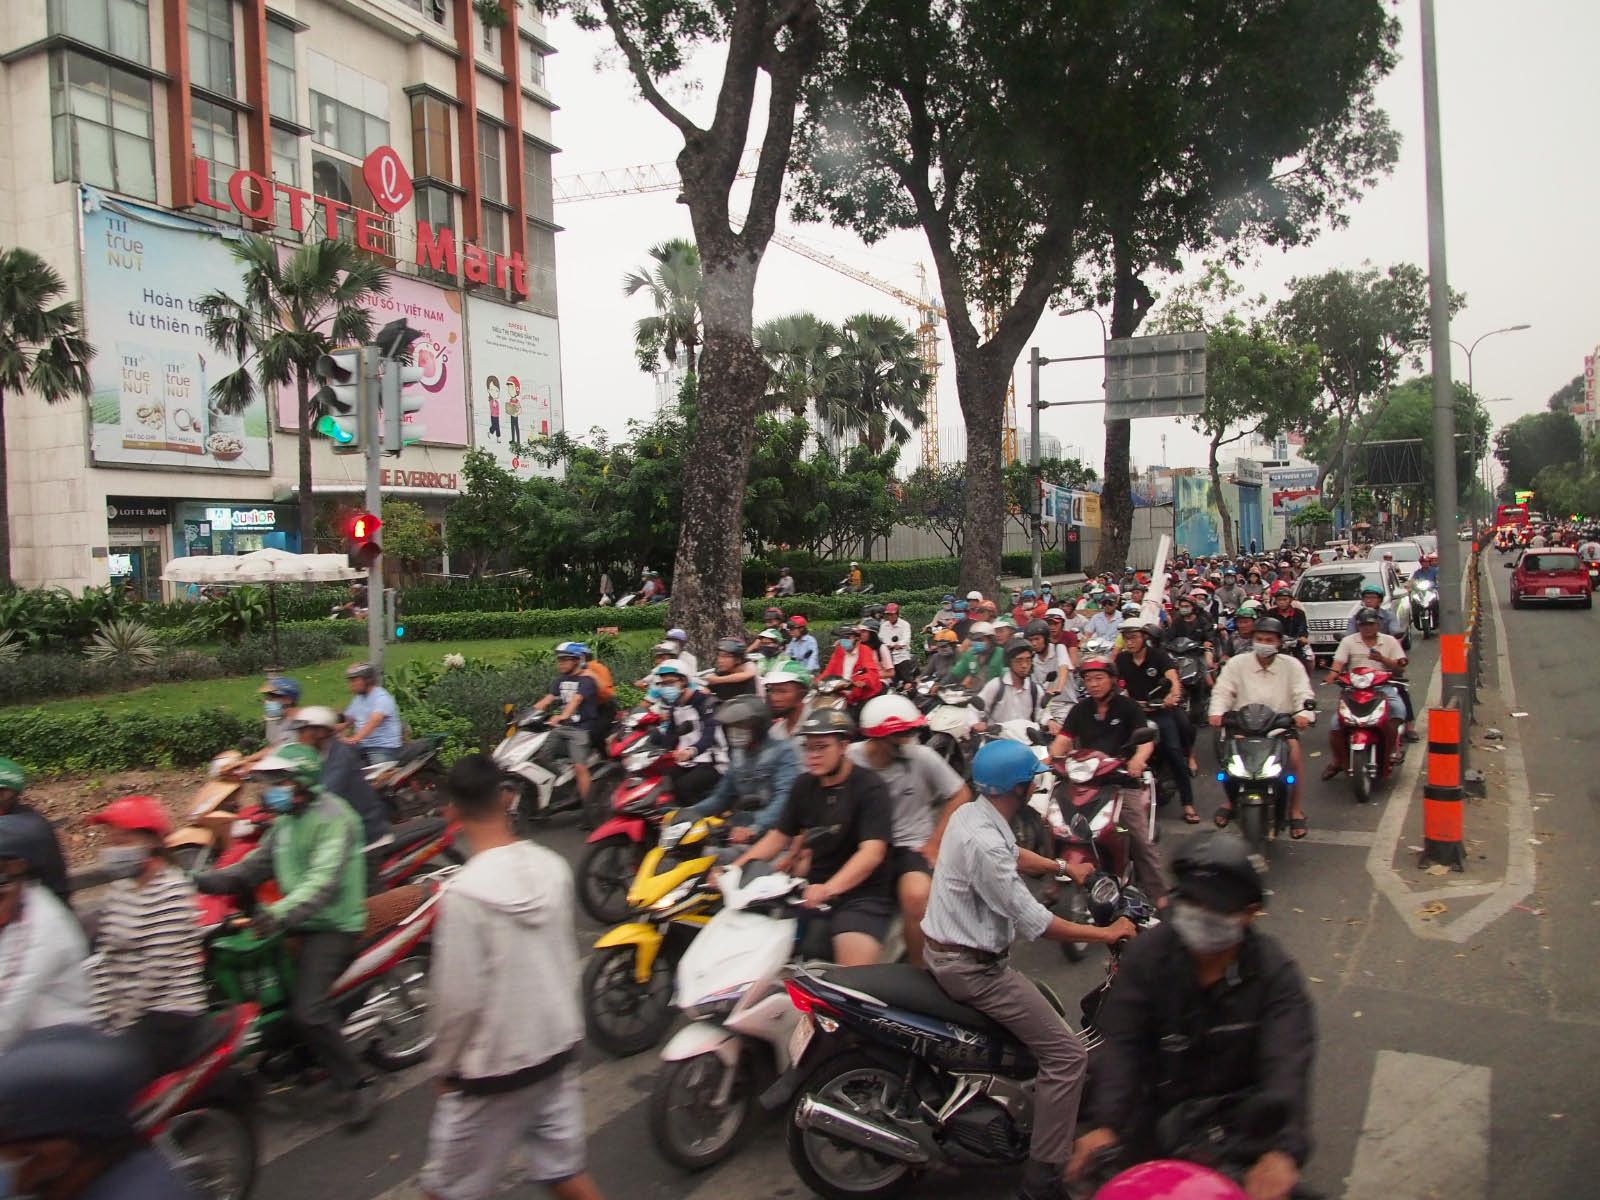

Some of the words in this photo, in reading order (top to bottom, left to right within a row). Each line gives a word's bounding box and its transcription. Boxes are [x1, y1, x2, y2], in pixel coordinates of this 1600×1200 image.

[194, 157, 386, 255] LOTTE
[416, 220, 529, 296] Mart
[105, 230, 144, 255] true
[106, 253, 145, 272] NUT
[142, 287, 184, 310] Hoàn
[403, 302, 421, 319] VIỆT
[423, 309, 444, 322] NAM
[149, 313, 190, 334] thiên
[122, 366, 151, 382] true
[166, 373, 191, 387] true
[1584, 355, 1596, 413] HOTEL
[122, 381, 151, 396] NUT
[166, 386, 190, 399] NUT
[393, 470, 457, 490] EVERRICH
[147, 508, 167, 516] Mart
